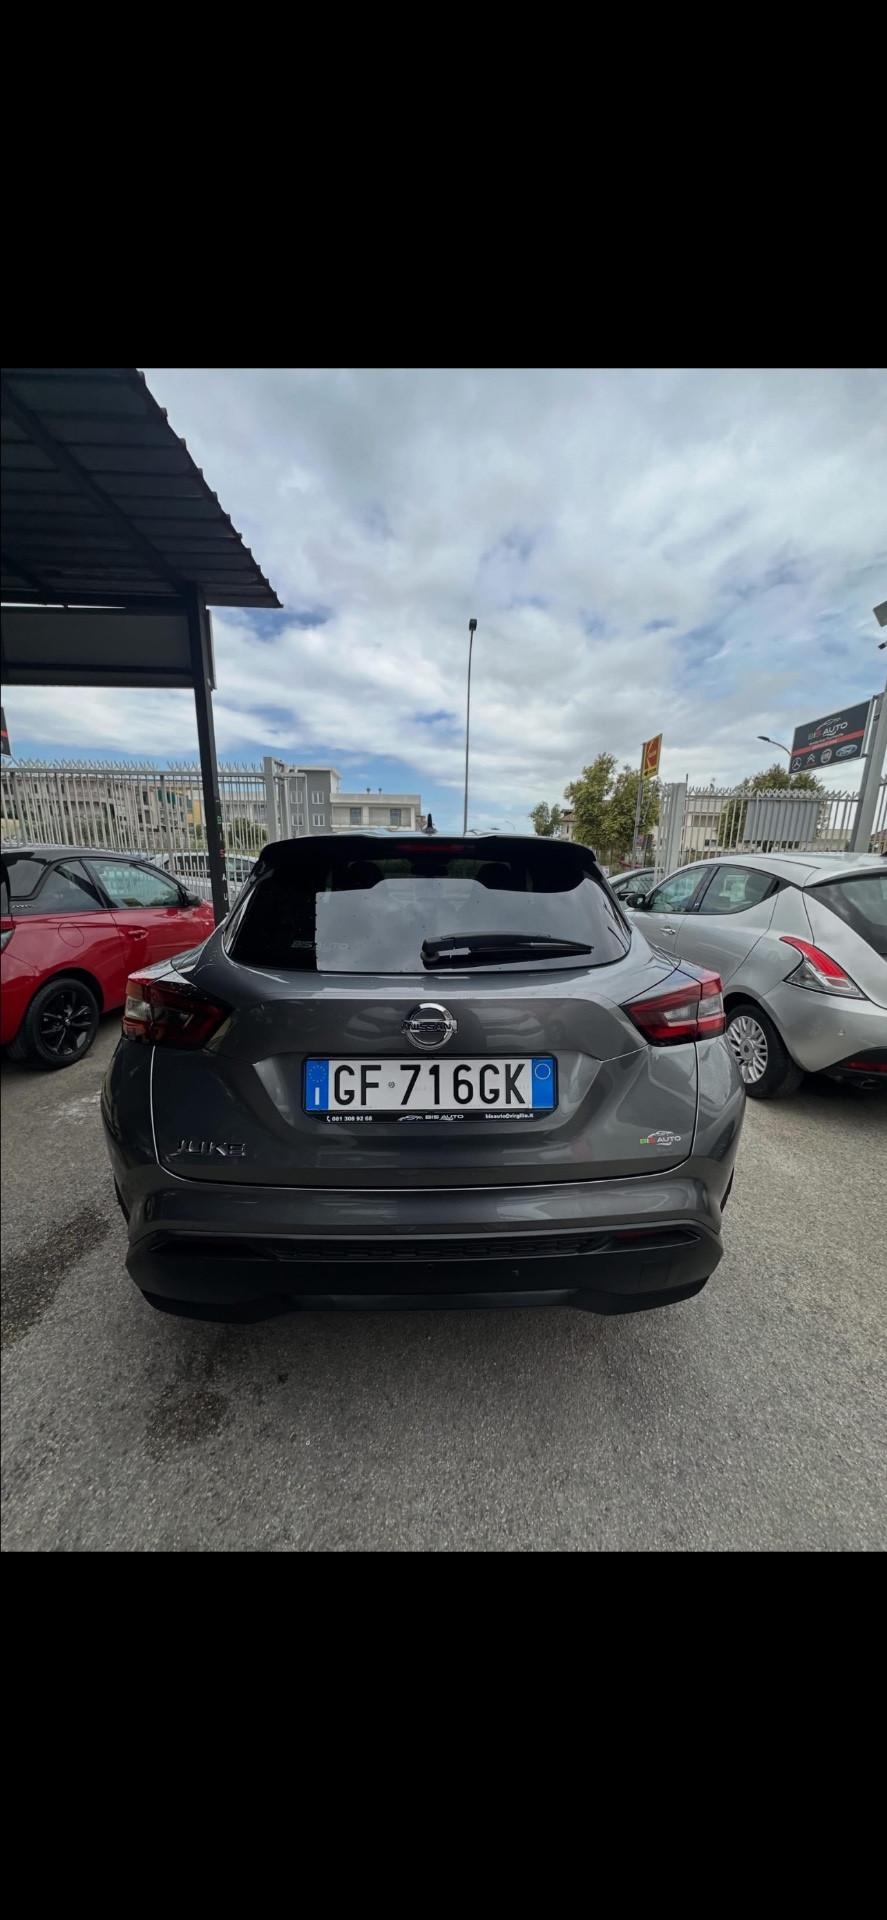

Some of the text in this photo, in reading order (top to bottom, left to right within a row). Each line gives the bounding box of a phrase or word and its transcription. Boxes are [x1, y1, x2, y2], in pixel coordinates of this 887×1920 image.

[823, 721, 848, 736] AUTO
[401, 1020, 457, 1033] NISSAN
[334, 1064, 382, 1105] GF
[400, 1064, 525, 1105] 716GK
[657, 1136, 682, 1144] AUTO
[169, 1140, 246, 1159] JUKE
